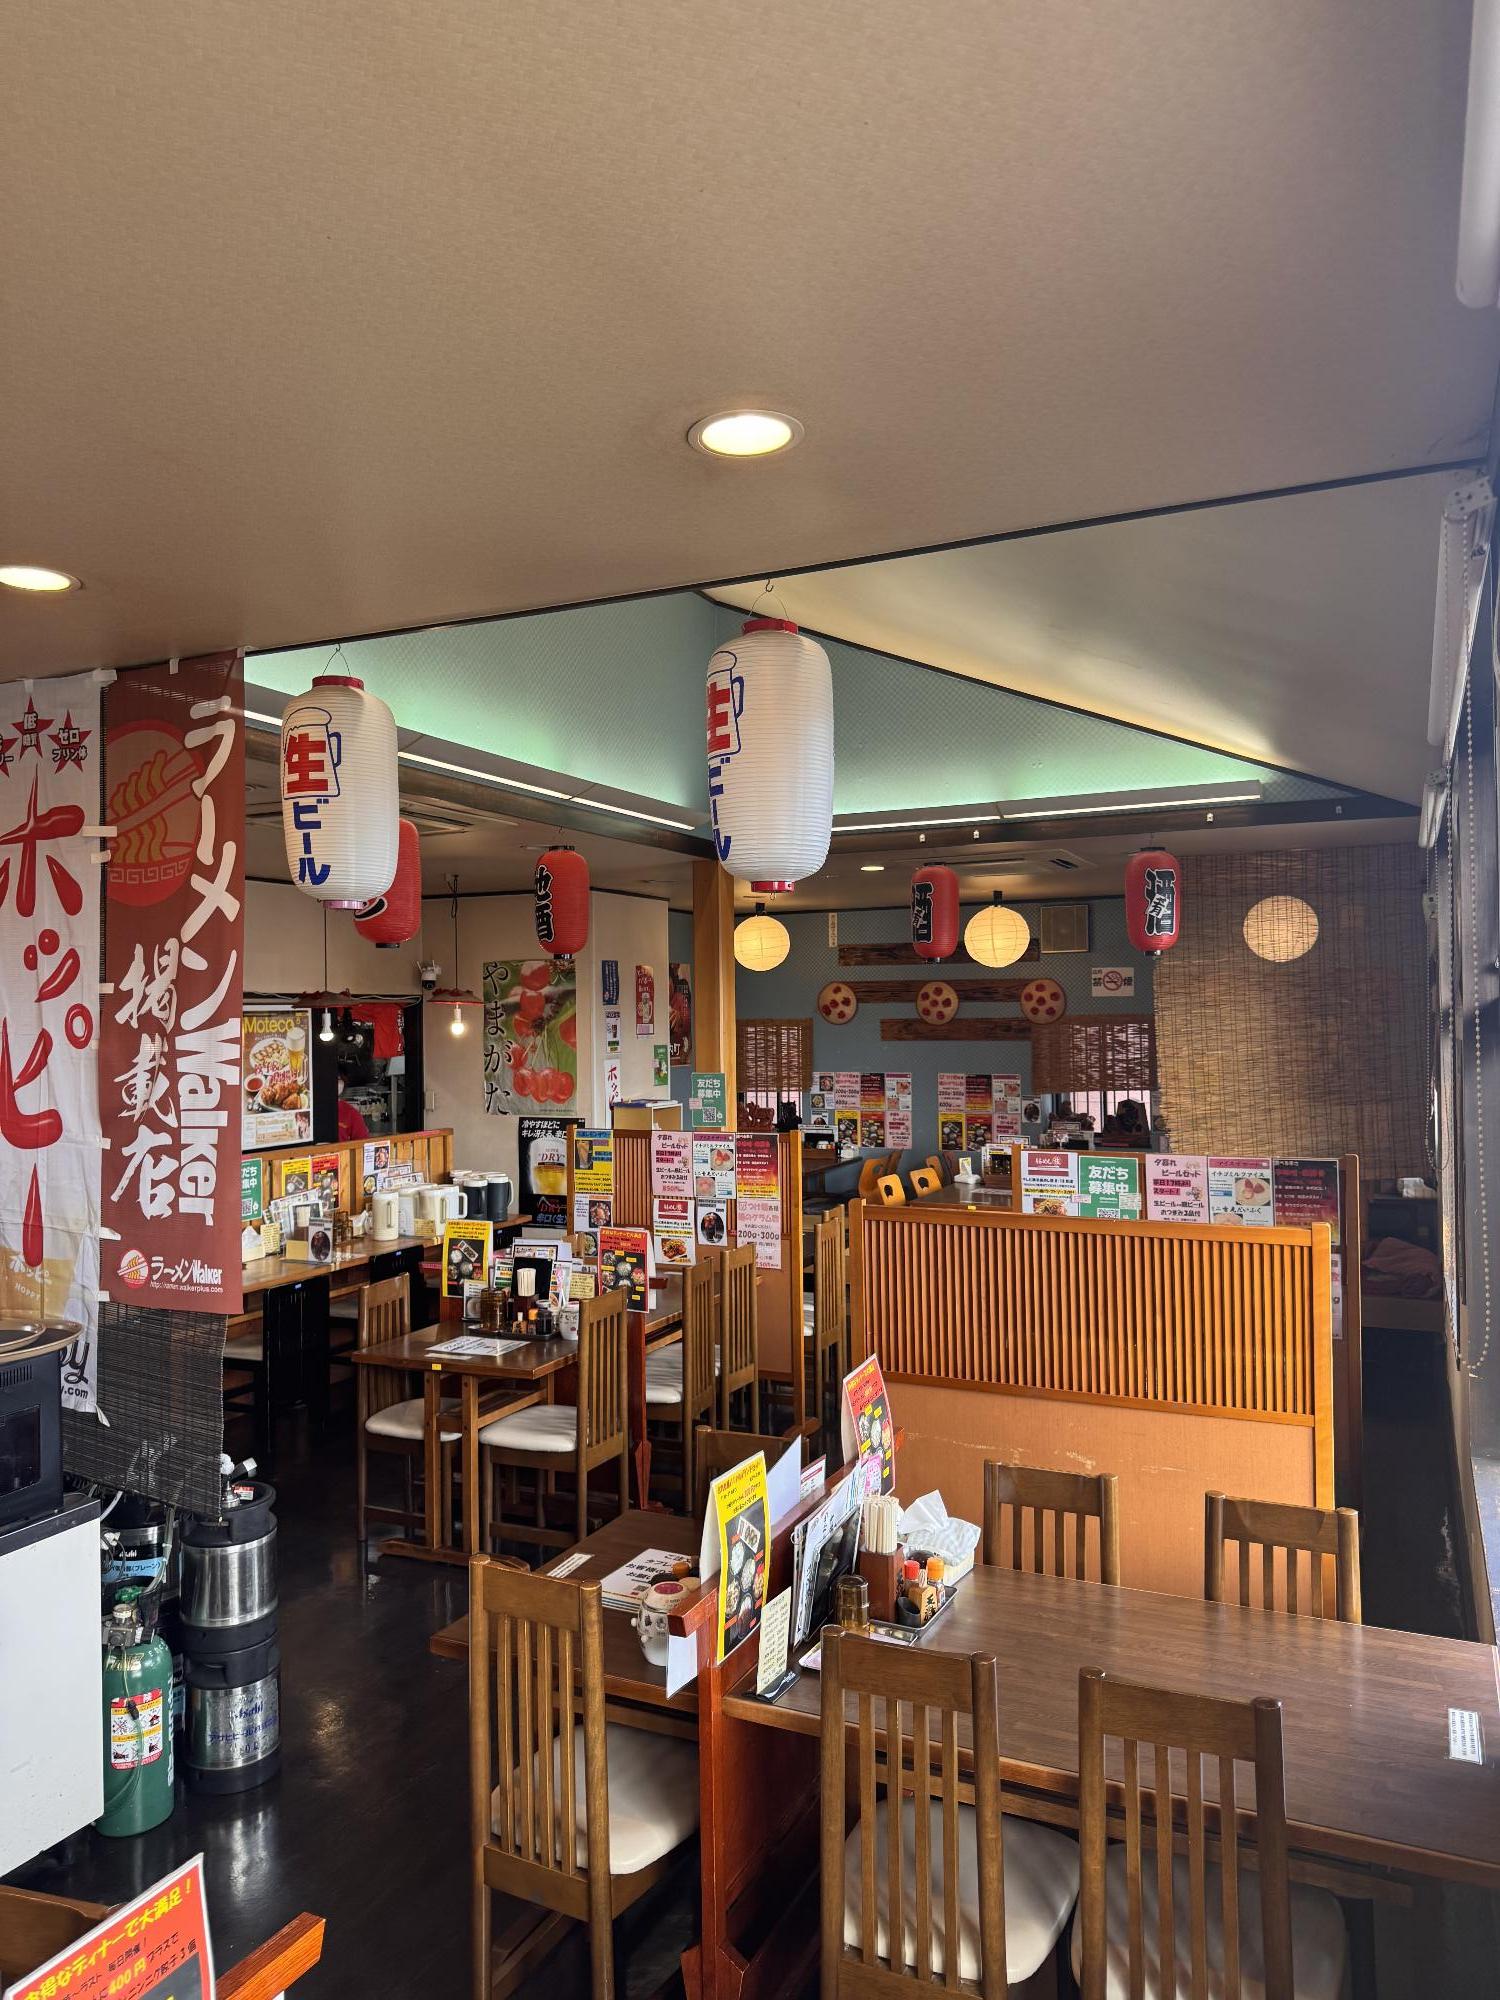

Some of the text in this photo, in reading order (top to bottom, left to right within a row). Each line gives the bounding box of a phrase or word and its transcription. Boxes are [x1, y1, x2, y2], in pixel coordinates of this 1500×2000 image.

[59, 729, 80, 744] ゼロ
[286, 732, 331, 886] 生ビール
[482, 961, 513, 1115] やまがた
[110, 937, 178, 1219] 掲載店
[697, 1079, 720, 1088] 友だち
[521, 1120, 561, 1129] 冷やすほどに
[1088, 1165, 1129, 1180] 友だち
[1161, 1169, 1201, 1178] ビールセット
[1088, 1181, 1129, 1195] 募集中
[150, 1256, 223, 1285] ラーメンWalker
